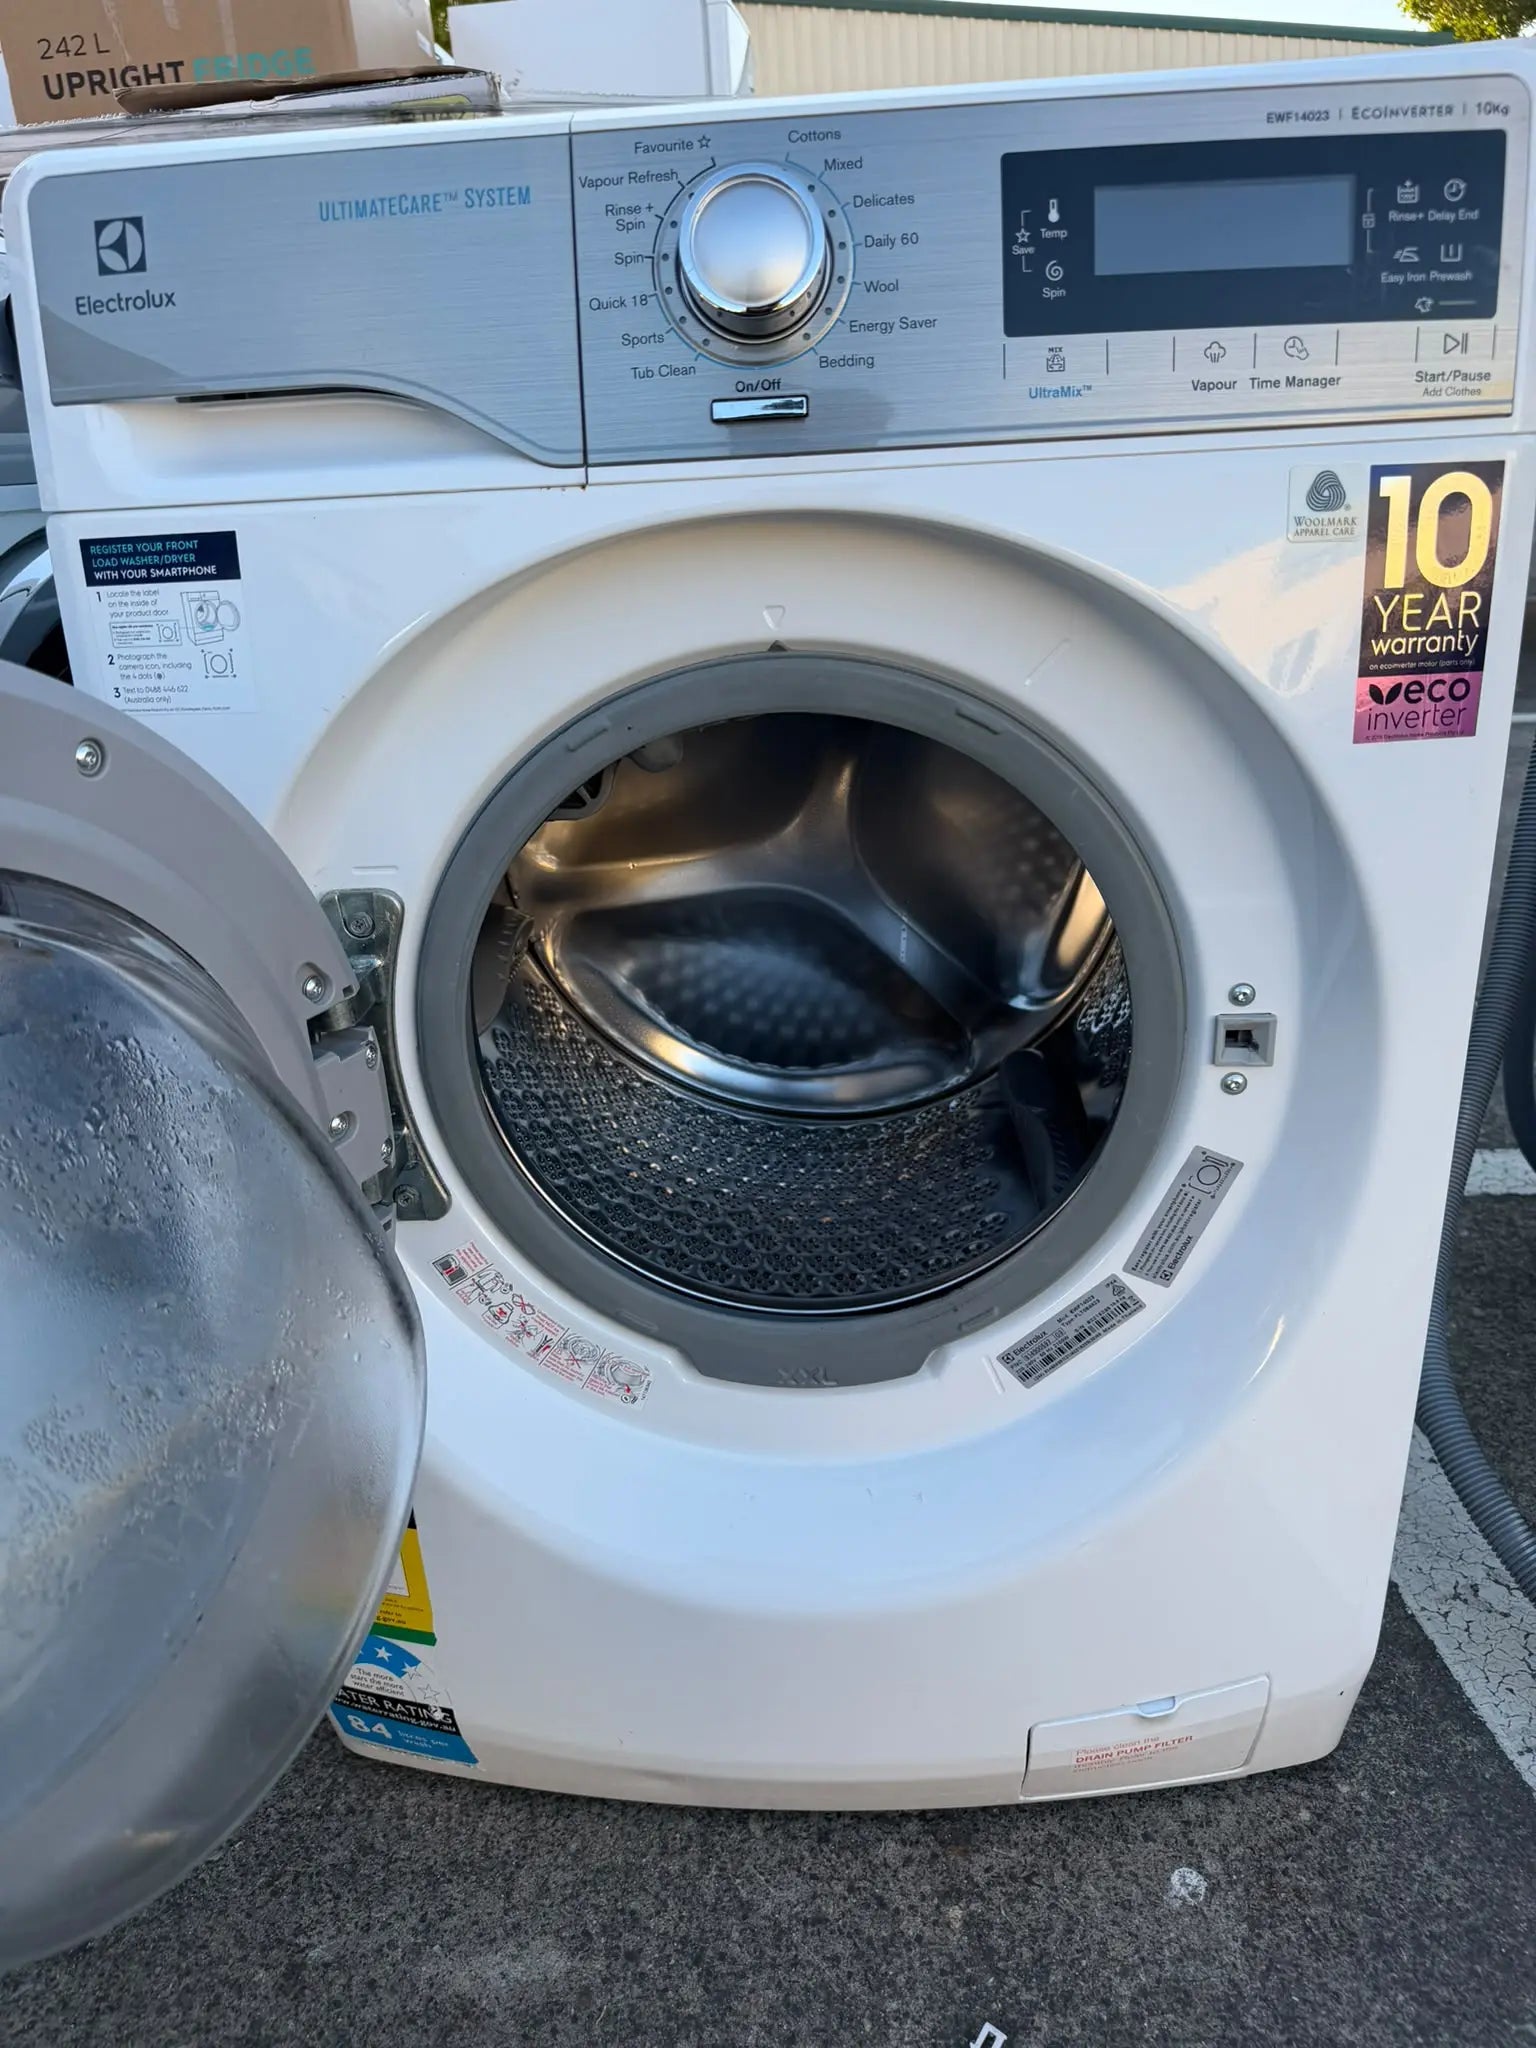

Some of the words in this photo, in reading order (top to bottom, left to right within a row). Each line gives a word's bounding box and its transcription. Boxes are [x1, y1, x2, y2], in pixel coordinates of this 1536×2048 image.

[37, 35, 88, 60] 242
[94, 33, 110, 55] L
[43, 60, 184, 101] UPRIGHT
[192, 47, 316, 84] FRIDGE
[1266, 110, 1330, 124] EWF14023
[788, 129, 841, 143] Cottons
[634, 139, 694, 154] Favourite
[824, 157, 863, 171] Mixed
[579, 174, 624, 190] Vapour
[628, 169, 678, 184] Refresh
[853, 192, 915, 208] Delicates
[605, 203, 642, 217] Rinse
[1428, 209, 1456, 223] Delay
[1458, 208, 1480, 220] End
[616, 218, 645, 232] Spin
[864, 235, 896, 250] Daily
[900, 232, 919, 246] 60
[1040, 227, 1068, 240] Temp
[1012, 245, 1035, 255] Save
[614, 252, 644, 266] Spin
[1380, 271, 1404, 285] Easy
[1406, 271, 1426, 282] Iron
[1430, 270, 1473, 281] Prewash
[863, 279, 899, 293] Wool
[1042, 287, 1066, 300] Spin
[75, 289, 176, 316] Electrolux
[589, 296, 627, 312] Quick
[632, 294, 648, 307] 18
[849, 320, 894, 335] Energy
[899, 316, 938, 330] Saver
[621, 332, 664, 347] Sports
[819, 355, 874, 370] Bedding
[631, 366, 655, 380] Tub
[658, 364, 696, 378] Clean
[1415, 370, 1491, 383] Start/Pause
[735, 378, 781, 393] On/Off
[1191, 378, 1237, 393] Vapour
[1249, 377, 1281, 390] Time
[1285, 375, 1341, 390] Manager
[1422, 387, 1442, 397] Add
[1445, 386, 1481, 397] Clothes
[1294, 516, 1357, 528] WOOLMARK
[1294, 527, 1330, 537] APPAREL
[1333, 527, 1355, 536] CARE
[1379, 471, 1492, 589] 10
[90, 543, 134, 555] REGISTER
[135, 541, 164, 553] YOUR
[165, 540, 199, 550] FRONT
[92, 557, 118, 568] LOAD
[120, 554, 196, 566] WASHER/DRYER
[94, 570, 118, 580] WITH
[121, 568, 148, 579] YOUR
[150, 565, 217, 578] SMARTPHONE
[96, 592, 101, 602] 1
[106, 590, 129, 598] Locate
[125, 610, 151, 618] product
[1374, 591, 1482, 632] YEAR
[1371, 630, 1479, 657] warranty
[107, 654, 115, 665] 2
[117, 653, 154, 662] Photograph
[119, 663, 144, 671] camera
[162, 662, 192, 671] including
[138, 672, 153, 680] dots
[113, 687, 121, 698] 3
[1404, 678, 1470, 704] eco
[124, 696, 154, 704] (Australia
[156, 695, 171, 704] only)
[1367, 704, 1467, 731] inverter
[1167, 1234, 1193, 1270] Electrolux
[1012, 1329, 1047, 1356] Electrolux
[356, 1668, 372, 1676] The
[373, 1673, 394, 1682] more
[338, 1688, 380, 1707] ATER
[383, 1700, 452, 1724] RATING
[347, 1715, 392, 1739] 84
[1075, 1752, 1113, 1763] DRAIN
[1116, 1745, 1152, 1756] PUMP
[1154, 1735, 1193, 1748] FILTER
